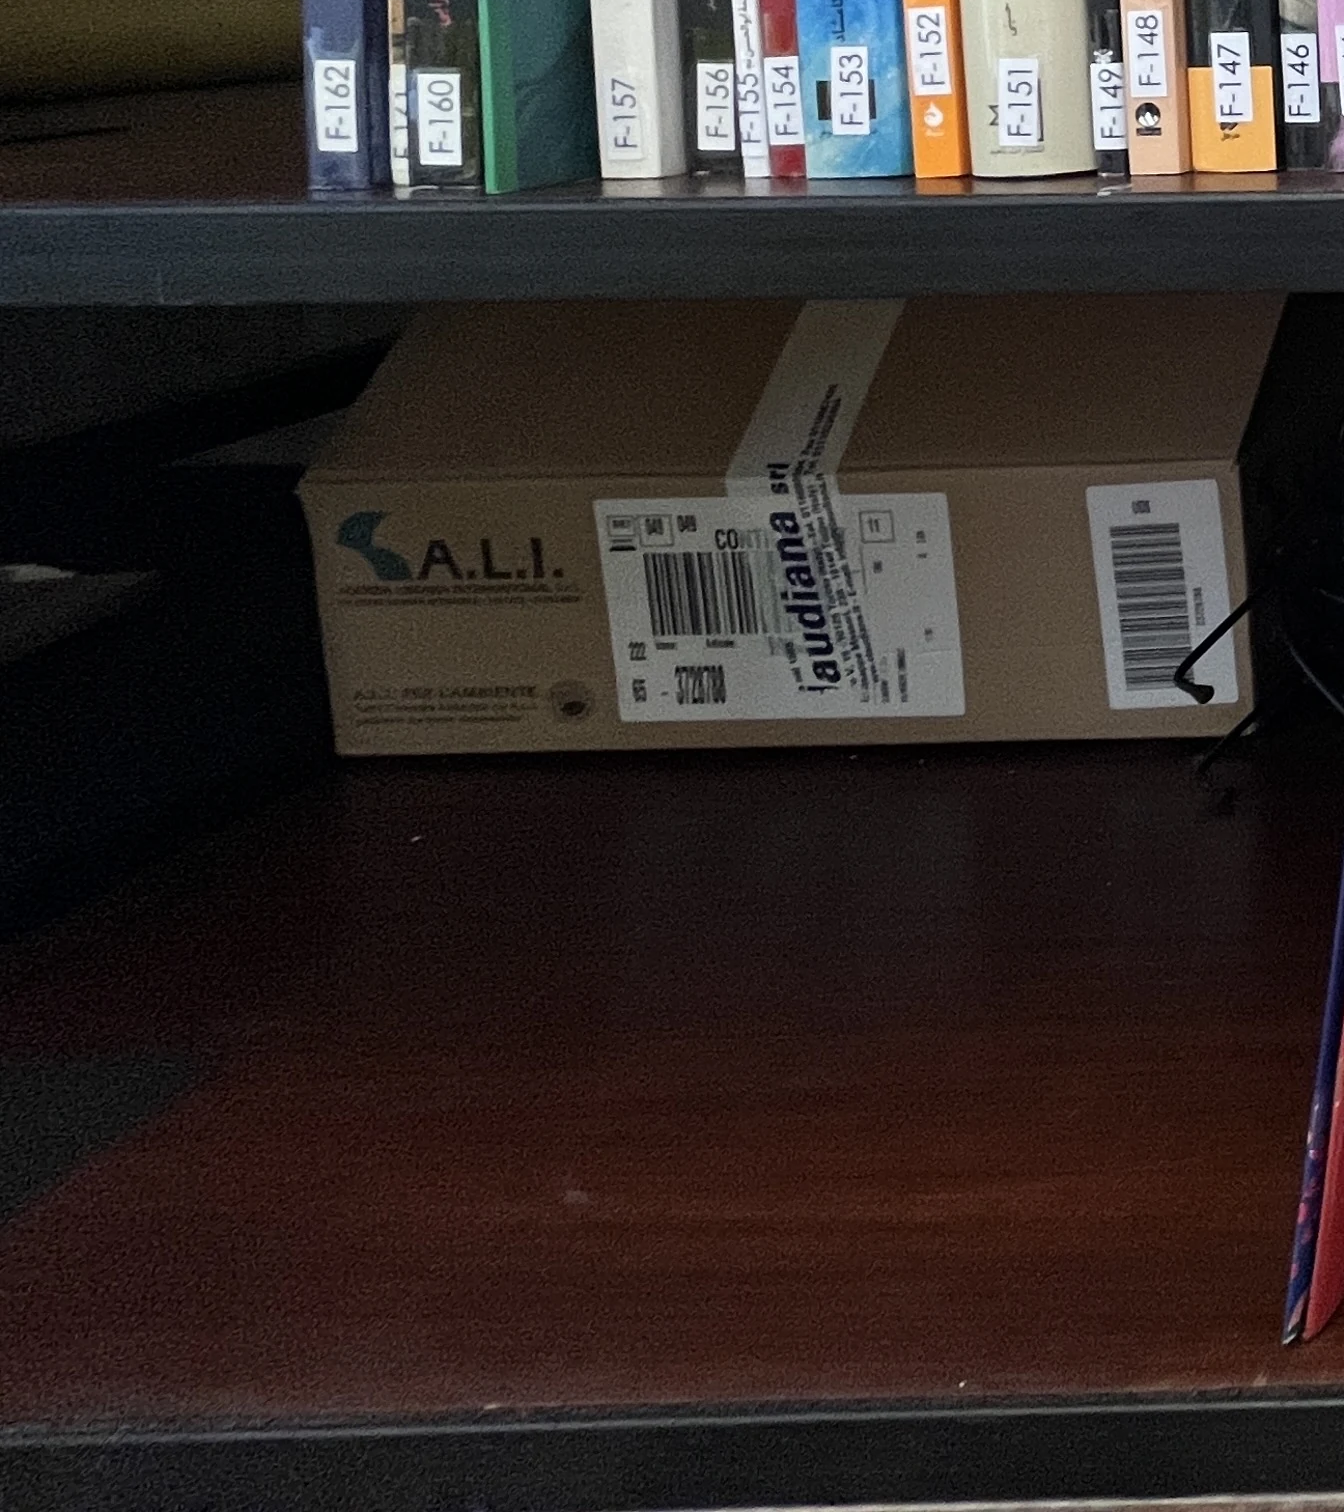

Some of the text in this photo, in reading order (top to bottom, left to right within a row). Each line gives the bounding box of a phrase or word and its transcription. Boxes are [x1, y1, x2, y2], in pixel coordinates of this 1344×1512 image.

[917, 13, 945, 86] F-152
[1133, 14, 1160, 86] F-148
[1217, 44, 1242, 117] F-147
[1285, 45, 1310, 117] F-146
[324, 66, 351, 141] F-162
[426, 80, 454, 154] F-160
[610, 78, 638, 149] F-157
[705, 68, 728, 138] F-156
[772, 66, 797, 136] F-154
[839, 54, 862, 126] F-153
[1007, 67, 1033, 137] F-151
[1099, 68, 1125, 140] F-149
[417, 537, 565, 580] A.L.I.
